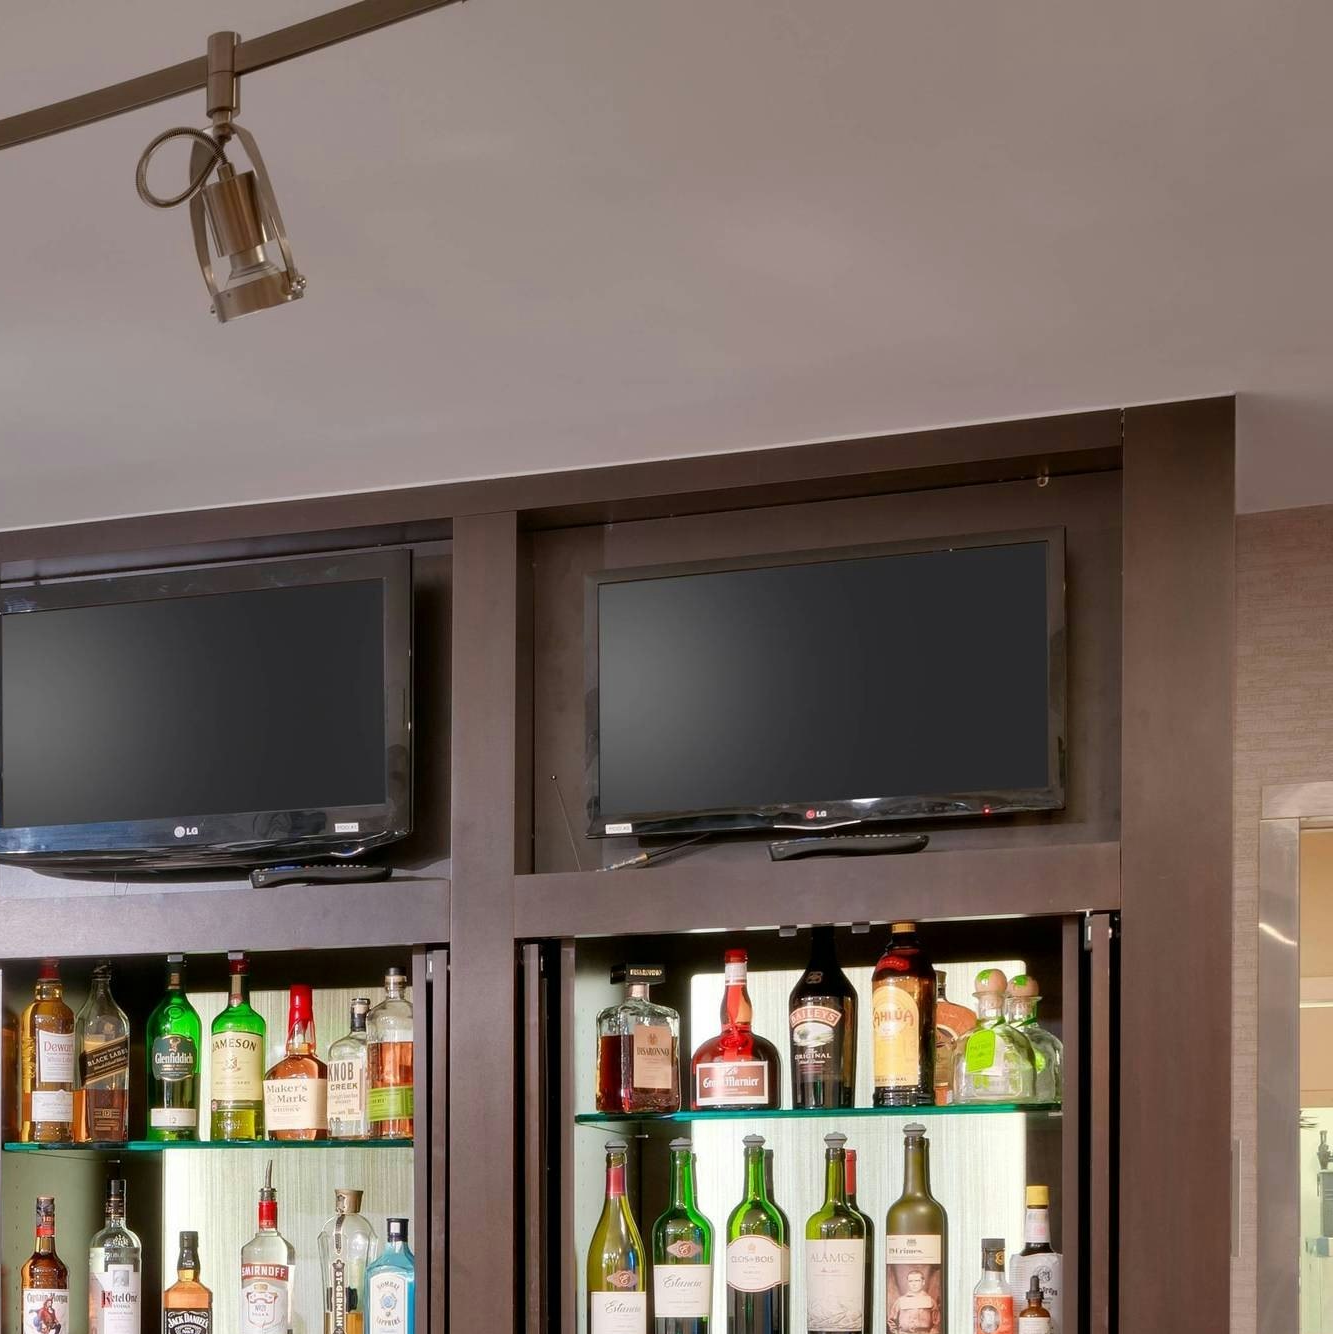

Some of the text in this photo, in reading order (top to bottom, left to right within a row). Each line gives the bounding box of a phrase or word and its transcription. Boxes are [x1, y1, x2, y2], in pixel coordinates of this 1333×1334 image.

[815, 810, 827, 818] LG
[186, 827, 199, 836] LG
[790, 1009, 838, 1024] BAILEYS
[212, 1038, 257, 1052] JAMESON
[637, 1046, 670, 1057] DISARONNO
[795, 1052, 832, 1060] ORIGINAL
[87, 1055, 109, 1067] BLACK
[155, 1052, 193, 1064] Glenfiddich
[328, 1062, 354, 1081] KNOB
[330, 1083, 358, 1091] CREEK
[725, 1076, 759, 1088] Marnier
[266, 1084, 308, 1094] Maker's
[276, 1094, 307, 1103] Mark
[755, 1255, 774, 1263] BOIS
[810, 1252, 855, 1263] ALAMOS
[377, 1280, 400, 1291] BOMBAY
[663, 1274, 702, 1289] Estancia
[27, 1292, 49, 1303] Captain
[101, 1290, 137, 1308] Ketel One
[335, 1272, 343, 1328] ST-GERMAIN
[605, 1300, 642, 1314] Estancia
[168, 1313, 209, 1329] JACK DANIEL'S
